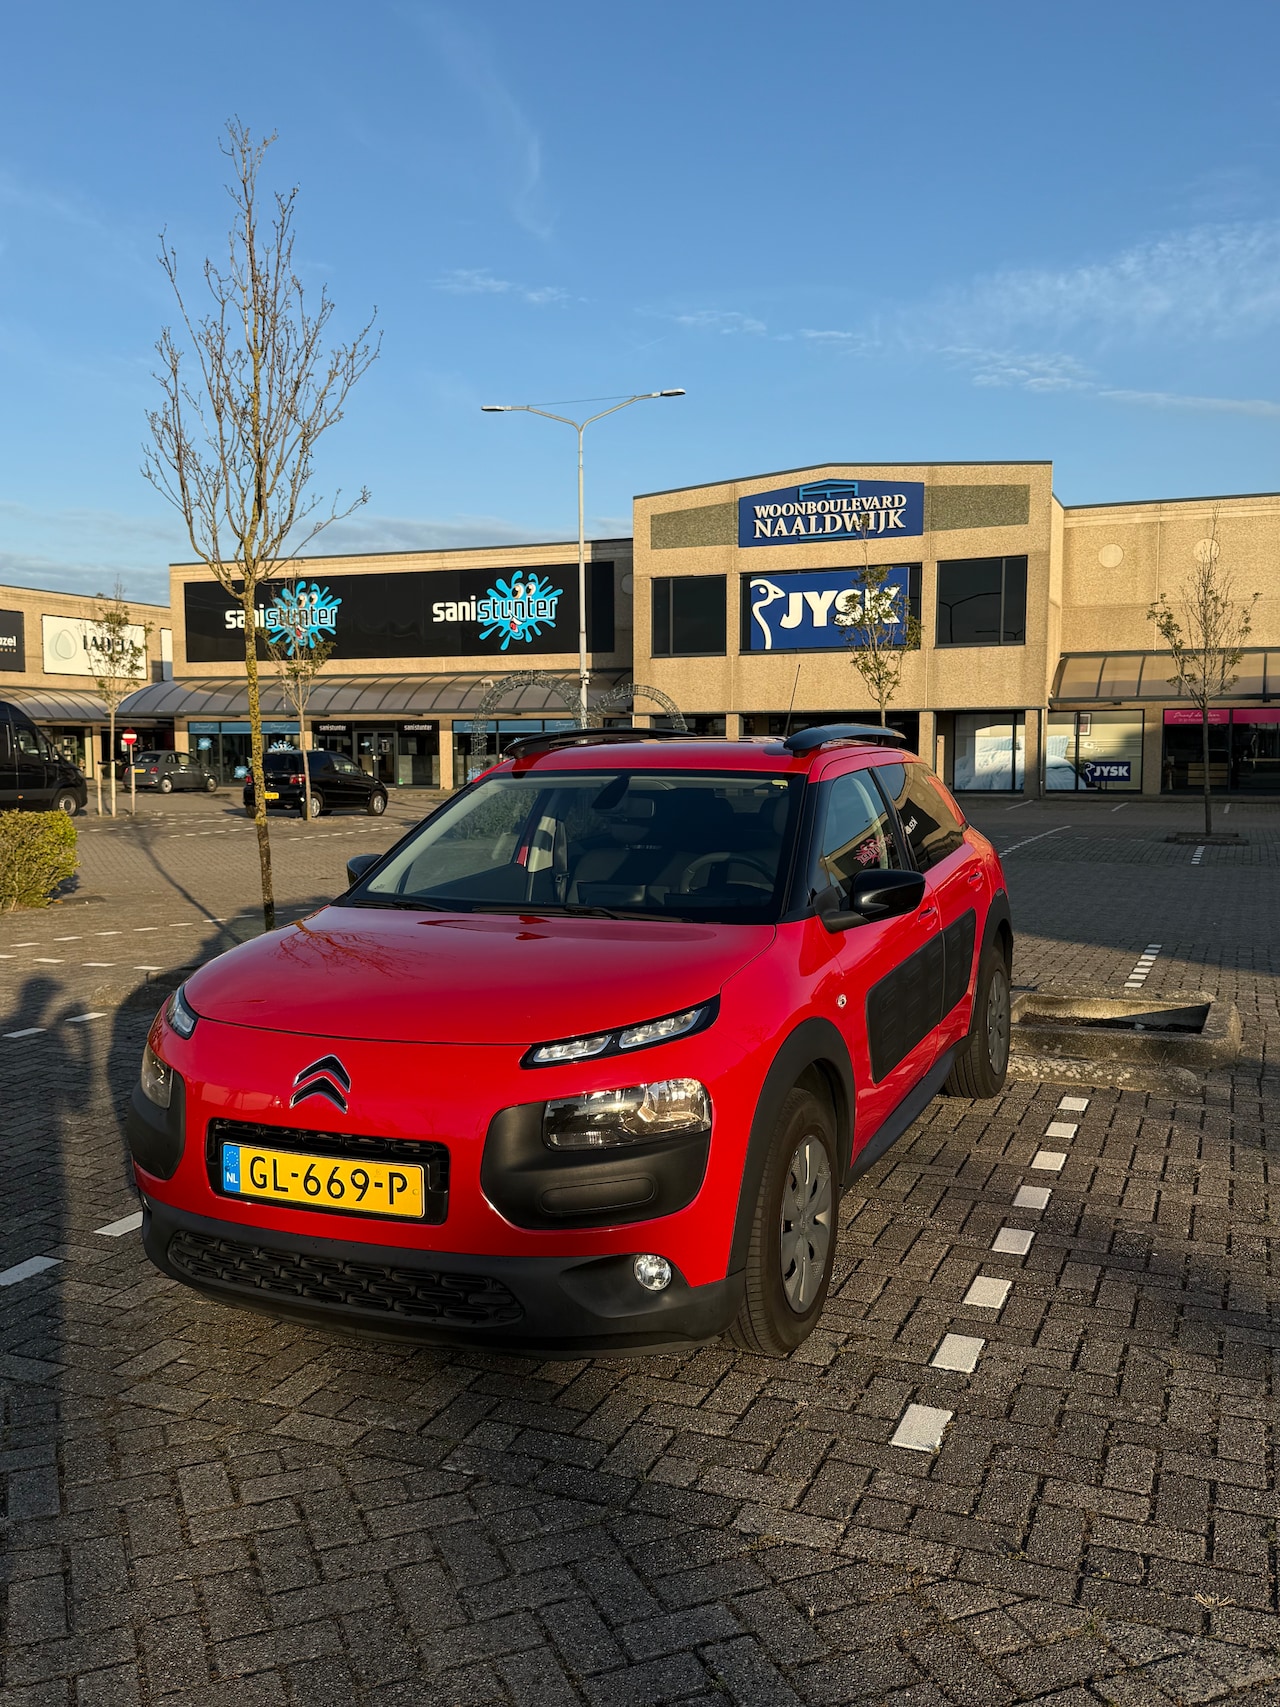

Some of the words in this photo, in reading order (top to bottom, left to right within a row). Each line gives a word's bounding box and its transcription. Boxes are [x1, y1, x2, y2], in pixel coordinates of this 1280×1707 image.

[753, 494, 907, 519] WOONBOULEVARD
[753, 508, 906, 539] NAALDWIJK
[432, 595, 559, 622] sanistunter
[780, 586, 900, 629] JYSK
[404, 723, 433, 731] sanistunter
[1094, 764, 1129, 777] JYSK
[226, 1172, 239, 1184] NL
[250, 1156, 408, 1205] GL-669-P
